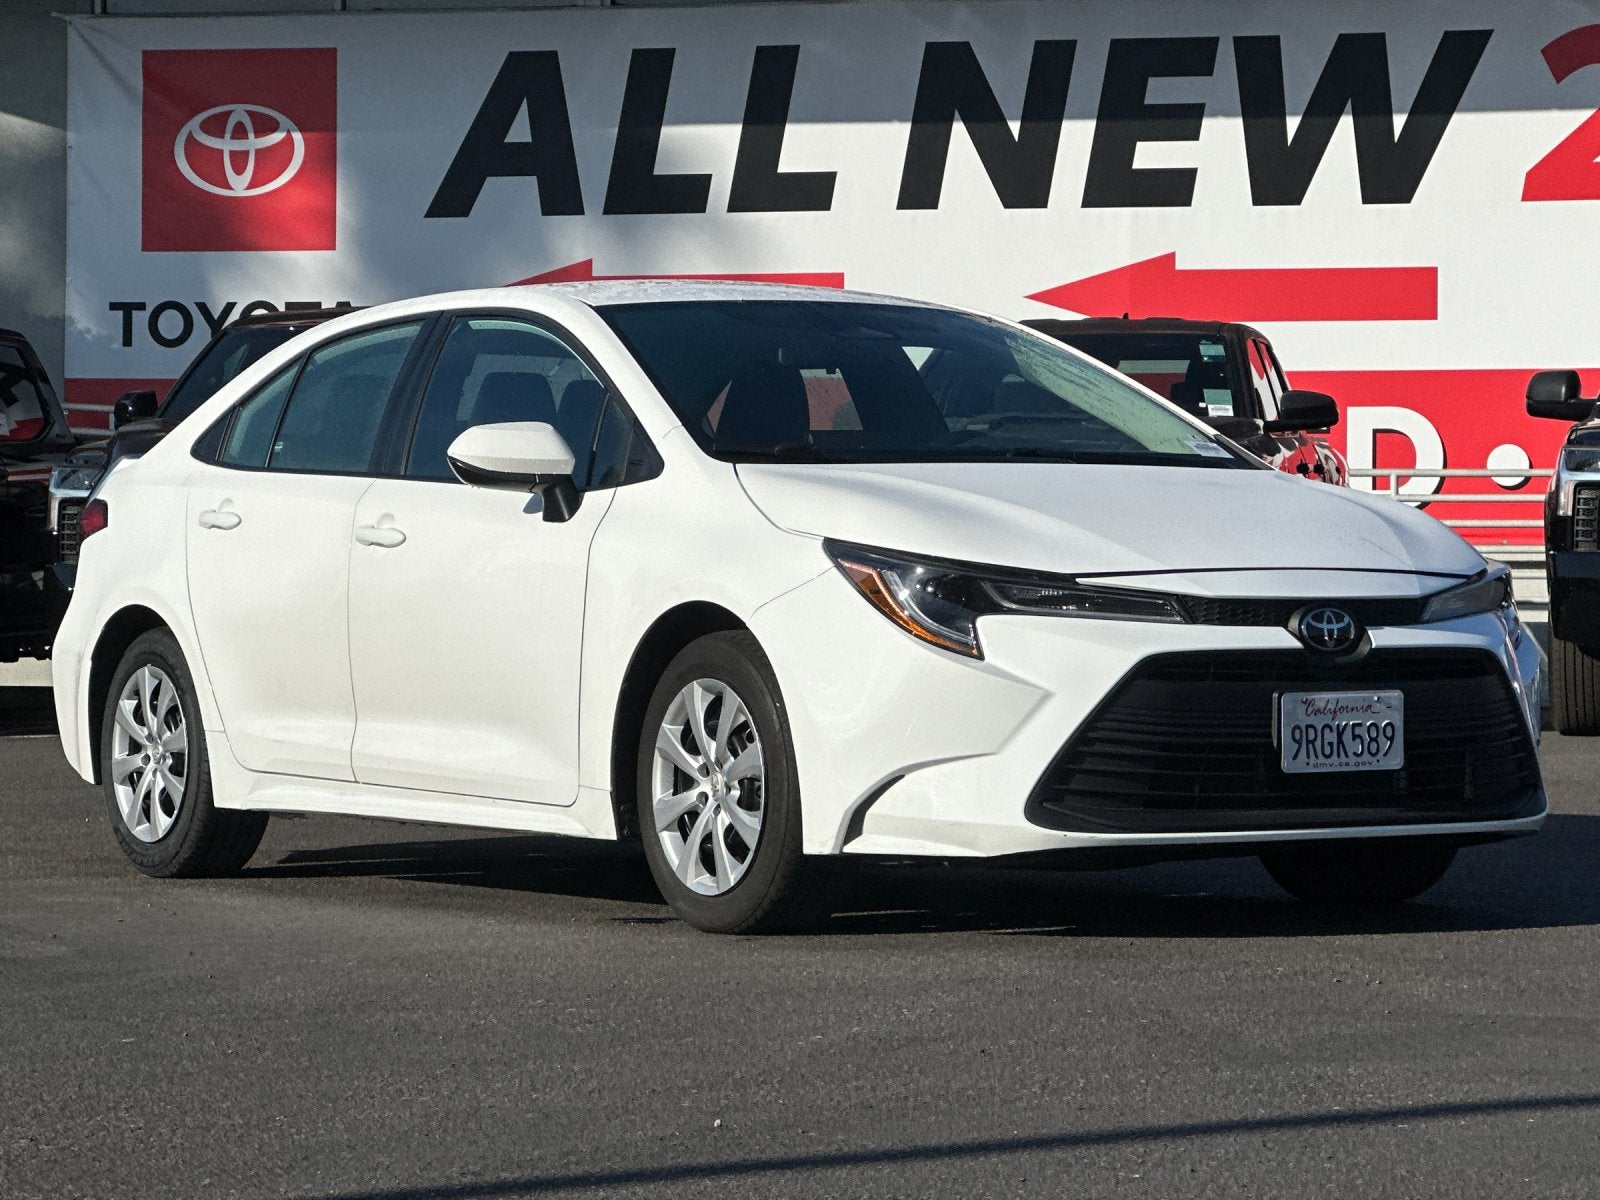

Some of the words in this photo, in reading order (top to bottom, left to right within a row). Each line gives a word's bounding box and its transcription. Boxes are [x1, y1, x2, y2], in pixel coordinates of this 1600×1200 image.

[423, 44, 838, 218] ALL
[896, 29, 1494, 210] NEW
[1305, 698, 1380, 721] California
[1291, 722, 1396, 761] 9RGK589
[1312, 761, 1374, 769] dmv.ca.gov
